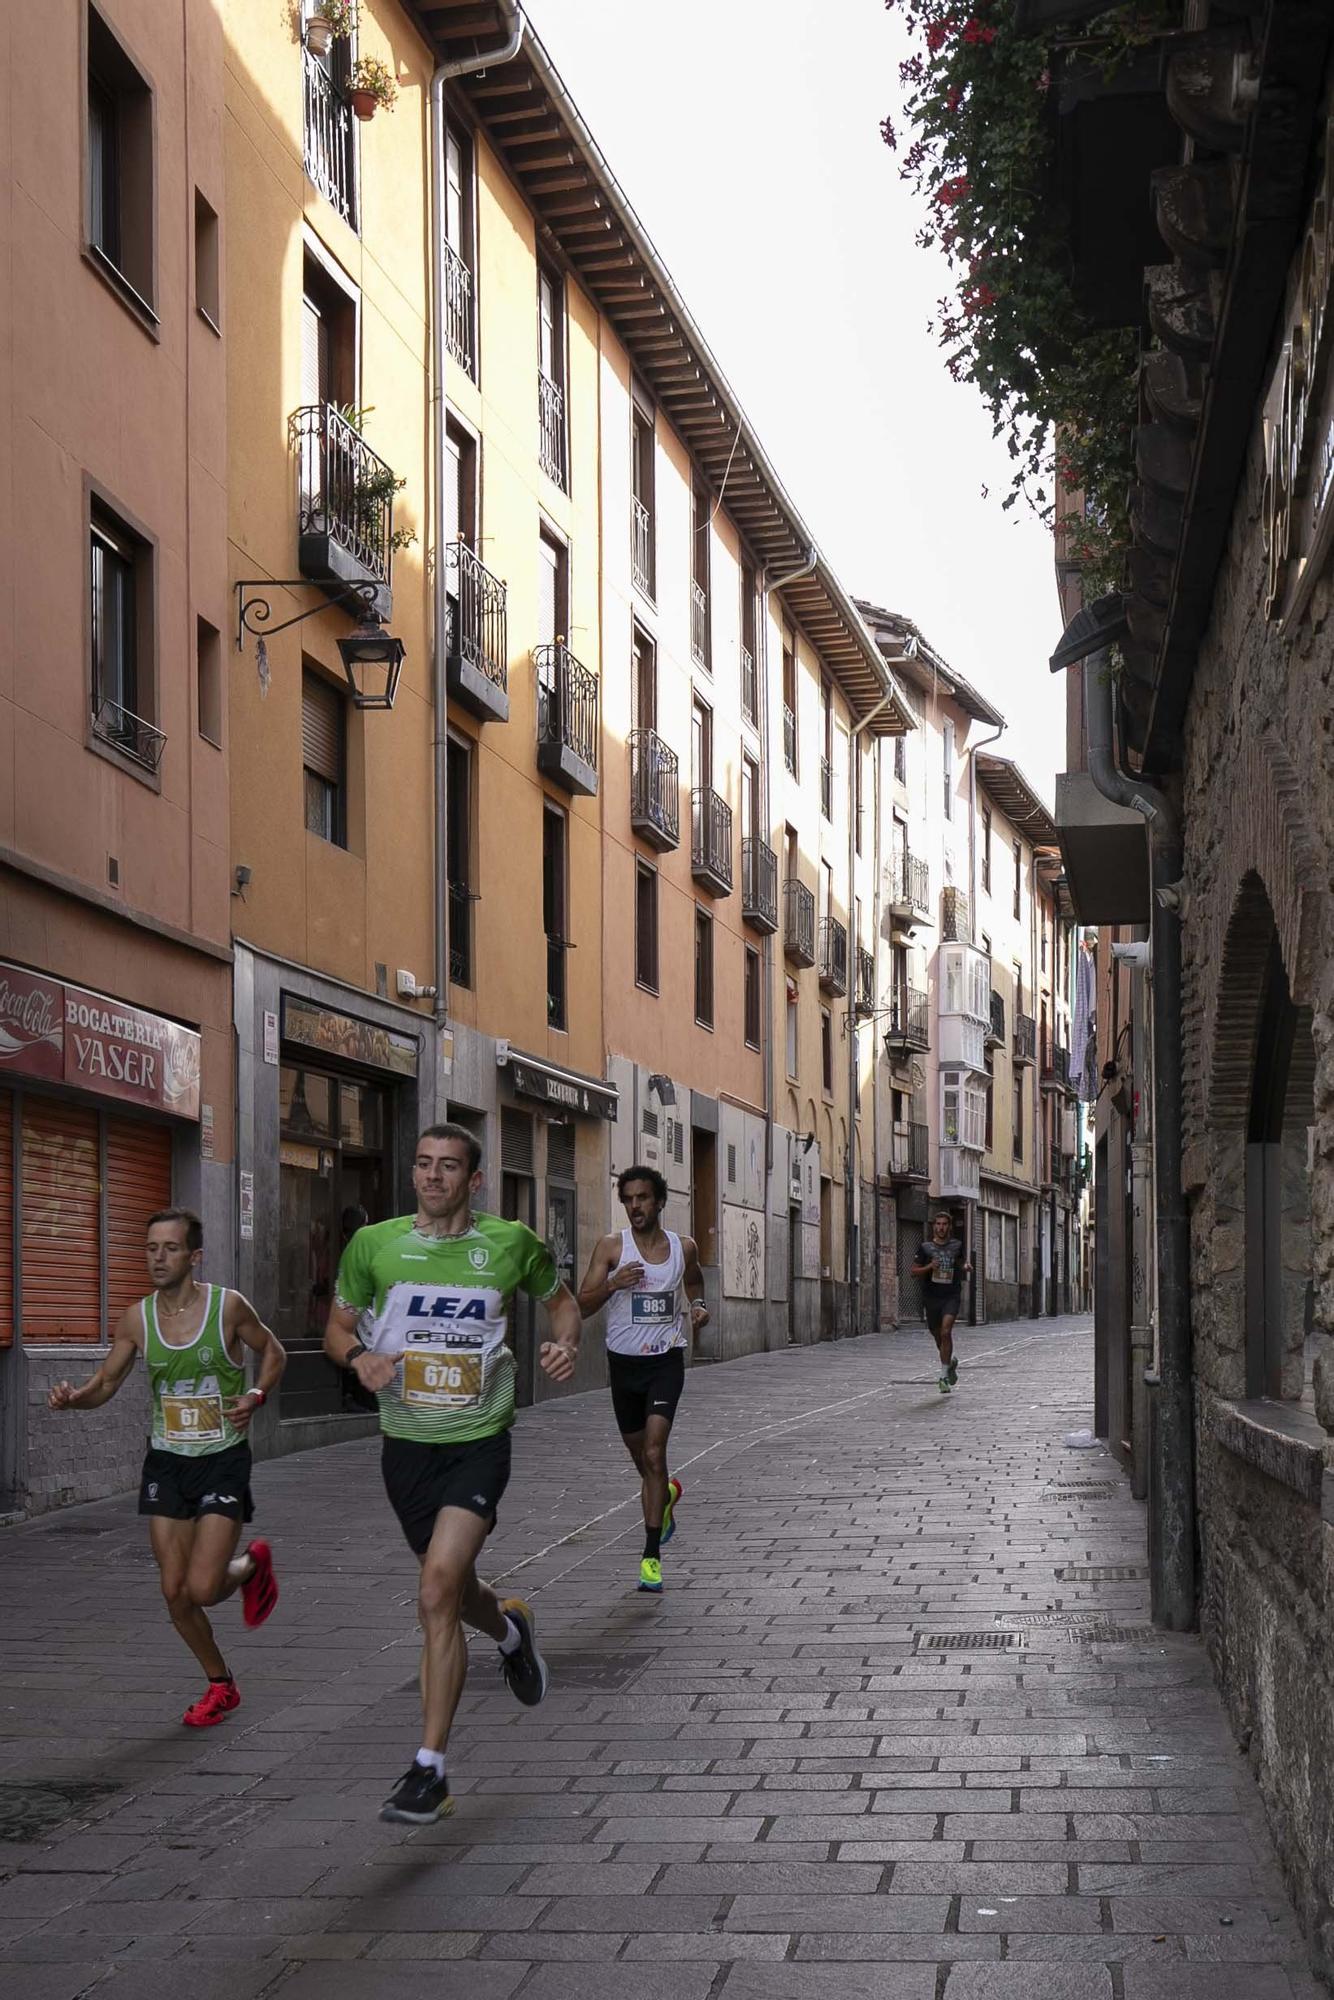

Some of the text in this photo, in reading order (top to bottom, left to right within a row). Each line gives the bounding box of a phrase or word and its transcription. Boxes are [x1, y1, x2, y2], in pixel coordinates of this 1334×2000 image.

[65, 1000, 162, 1051] BOCATERIA
[73, 1033, 157, 1089] YASER
[407, 1295, 486, 1320] LEA
[642, 1299, 666, 1313] 983
[406, 1330, 484, 1344] Gama
[160, 1375, 220, 1396] LEA
[424, 1365, 462, 1388] 676
[181, 1408, 199, 1427] 67
